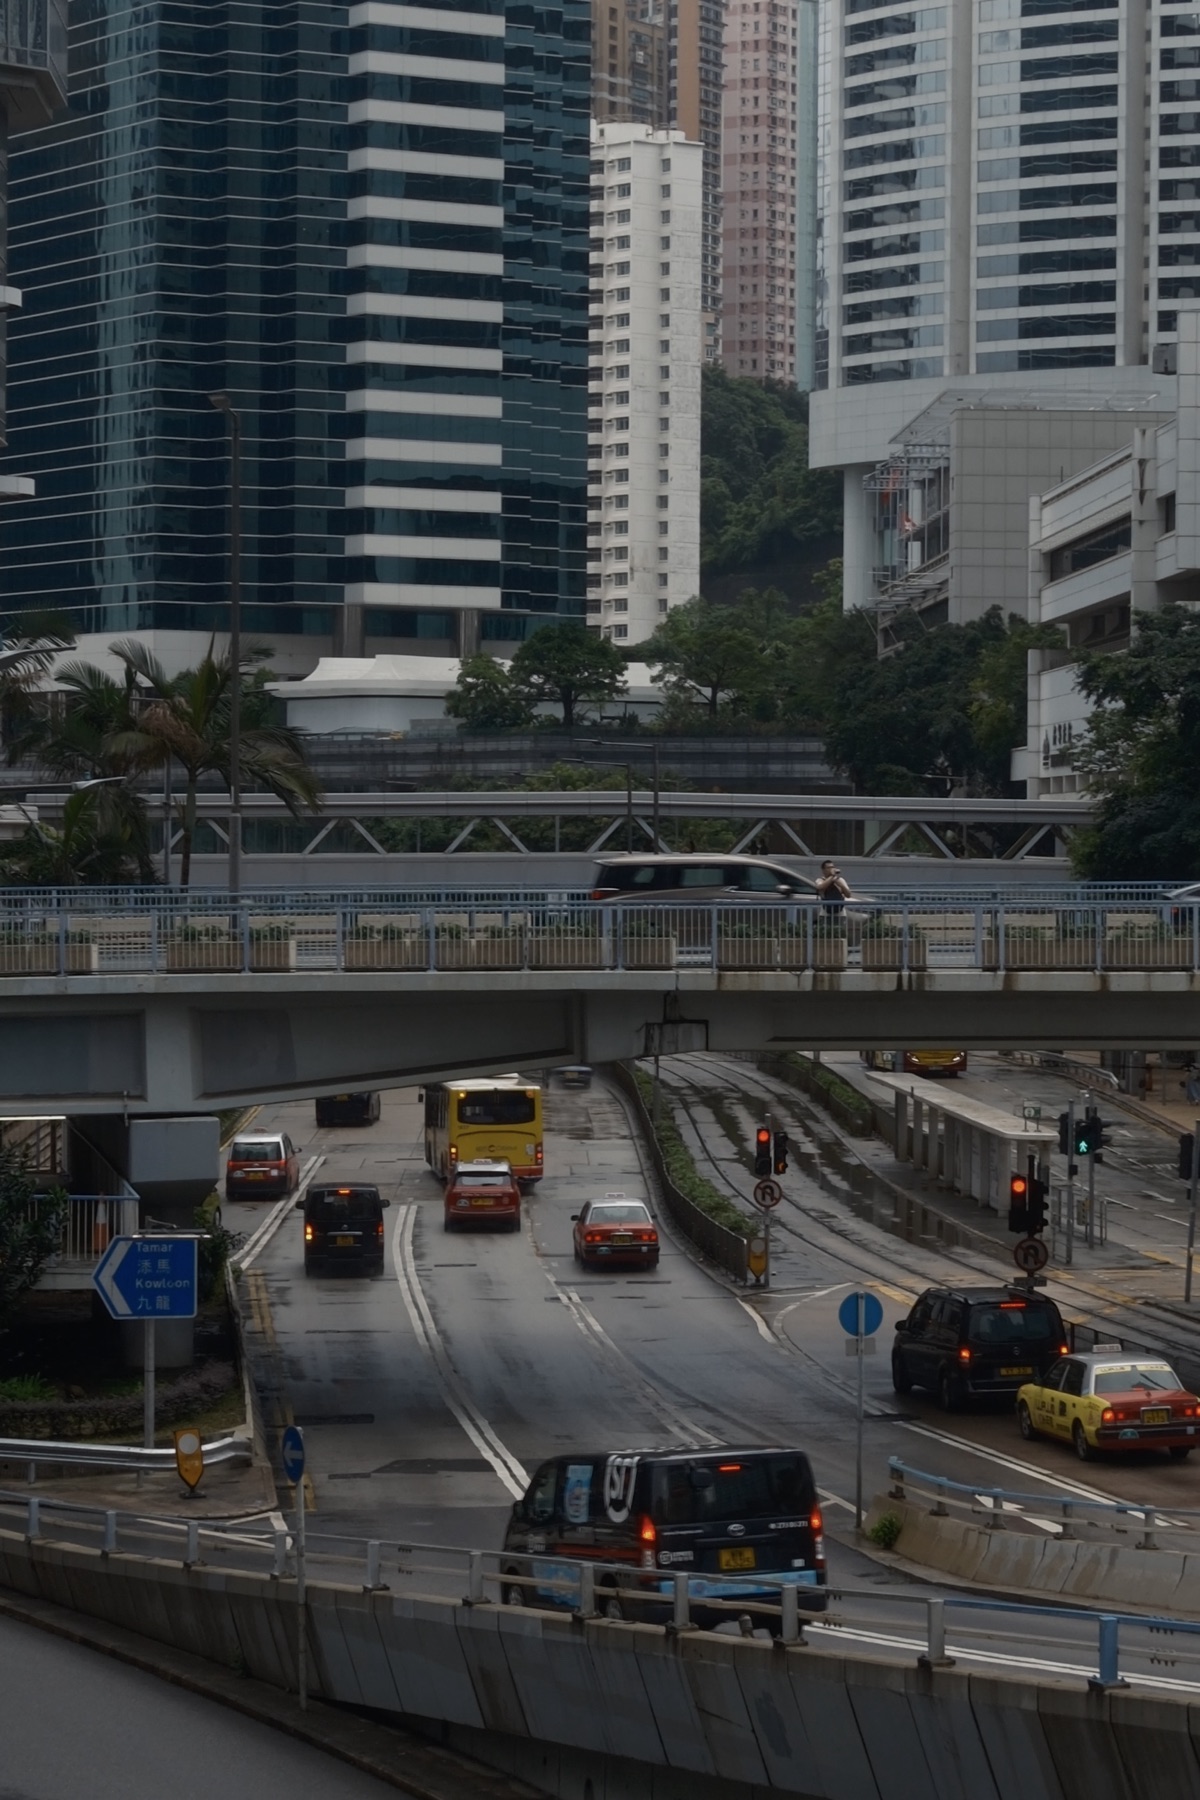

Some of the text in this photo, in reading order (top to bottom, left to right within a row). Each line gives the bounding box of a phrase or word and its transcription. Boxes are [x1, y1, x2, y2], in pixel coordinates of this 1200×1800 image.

[136, 1242, 174, 1253] Tamar
[137, 1258, 171, 1274] 添馬
[135, 1278, 190, 1289] Kowloon
[137, 1295, 171, 1311] 九龍
